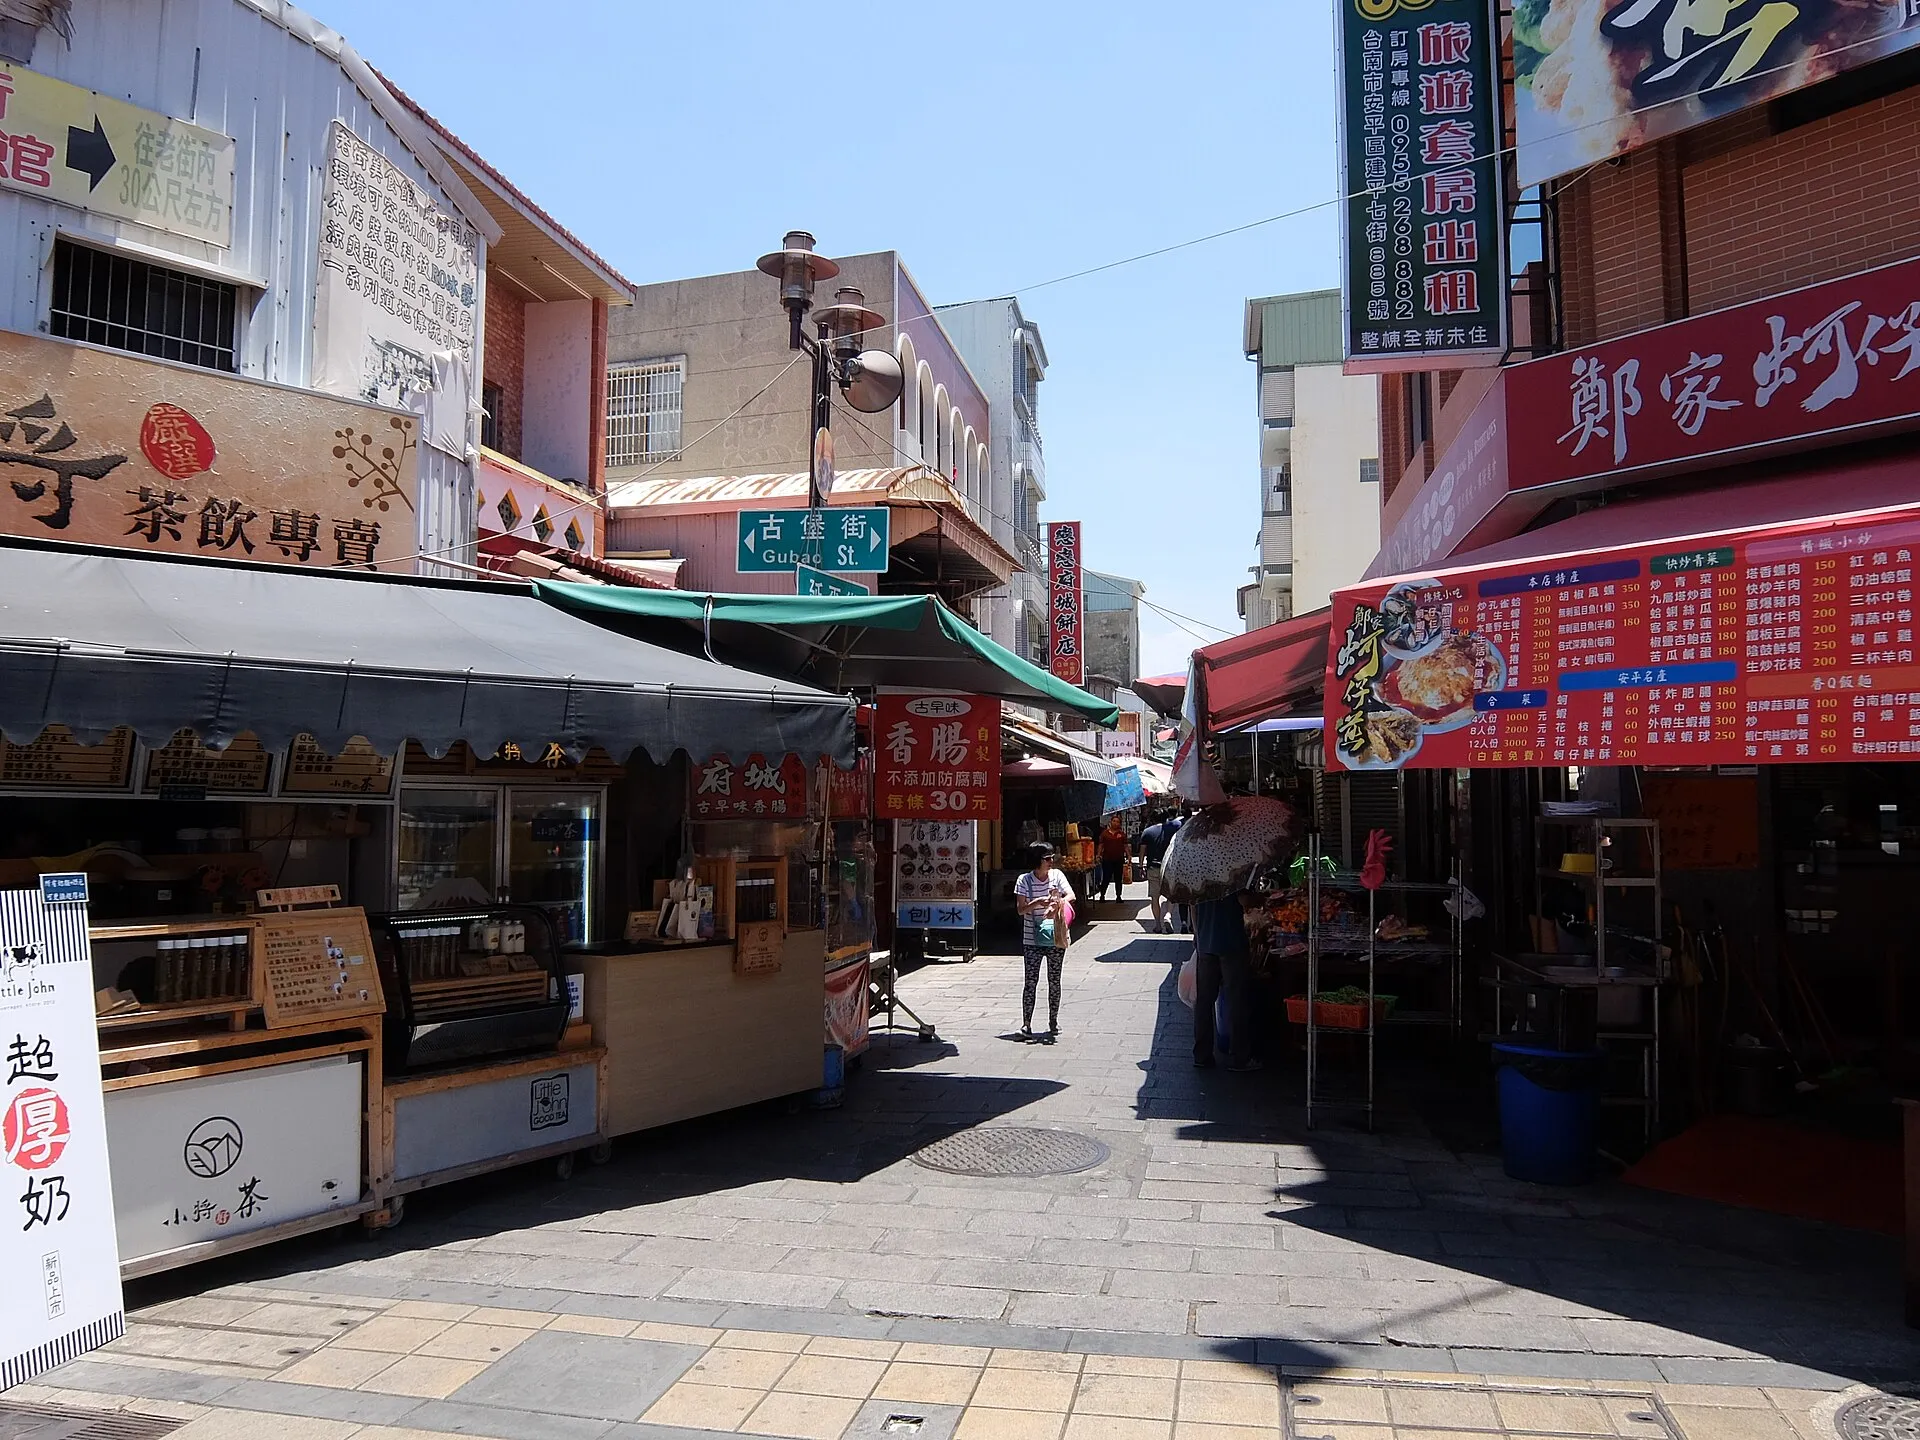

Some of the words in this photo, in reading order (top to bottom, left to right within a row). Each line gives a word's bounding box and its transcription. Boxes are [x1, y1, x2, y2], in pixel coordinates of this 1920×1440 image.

[1389, 30, 1411, 107] 訂房專線
[134, 120, 217, 185] 往老街內
[1361, 30, 1390, 320] 台南市安平區建平七街885號
[1417, 21, 1481, 316] 旅遊套房出租
[119, 164, 224, 234] 30公尺左方
[1361, 325, 1488, 350] 整棟全新未住
[123, 486, 382, 572] 茶飲專賣
[759, 513, 867, 541] 古堡街
[762, 549, 823, 564] Gubao
[837, 544, 859, 566] St.
[1665, 552, 1720, 570] 快炒青菜
[1850, 550, 1912, 567] 紅燒魚
[1815, 560, 1836, 570] 150
[1528, 570, 1580, 588] 本店特產
[1650, 573, 1713, 591] 炒青菜
[1717, 572, 1737, 582] 100
[1746, 579, 1800, 595] 快炒羊肉
[1812, 576, 1836, 586] 200
[809, 578, 858, 597] 延平
[1622, 584, 1640, 593] 350
[1423, 587, 1463, 603] 傳統小吃
[1650, 588, 1713, 604] 九層塔炒蛋
[1717, 587, 1737, 597] 100
[1812, 592, 1836, 602] 200
[1850, 589, 1912, 606] 三杯中卷
[1458, 605, 1470, 613] 60
[1476, 597, 1521, 612] 炒孔雀蛤
[1534, 594, 1551, 603] 300
[1622, 601, 1640, 610] 350
[1717, 602, 1737, 611] 180
[1533, 606, 1551, 615] 200
[1812, 608, 1836, 618] 200
[1851, 609, 1912, 626] 清蒸中卷
[1351, 606, 1384, 634] 鄭家
[1458, 616, 1469, 625] 60
[1533, 617, 1550, 627] 200
[1623, 617, 1640, 627] 180
[1717, 616, 1737, 626] 180
[1458, 628, 1469, 637] 60
[1533, 629, 1550, 638] 200
[1717, 631, 1737, 641] 180
[1746, 626, 1801, 641] 鐵板豆腐
[1812, 624, 1836, 634] 200
[1533, 641, 1550, 650] 200
[1717, 646, 1737, 656] 180
[1813, 640, 1837, 650] 250
[1532, 652, 1550, 661] 250
[1851, 649, 1912, 665] 三杯羊肉
[1532, 664, 1549, 673] 300
[1747, 658, 1802, 673] 生炒花枝
[1813, 657, 1837, 667] 200
[1532, 676, 1549, 685] 250
[1618, 670, 1668, 685] 安平名產
[1626, 692, 1639, 701] 60
[1649, 686, 1711, 701] 酥炸肥腸
[1717, 686, 1737, 695] 180
[915, 701, 961, 715] 古早味
[1625, 707, 1638, 716] 60
[1648, 701, 1711, 715] 炸中卷
[1715, 701, 1736, 710] 300
[1747, 699, 1809, 712] 招牌蒜頭飯
[1817, 699, 1837, 708] 100
[1505, 713, 1529, 721] 1000
[1537, 711, 1548, 722] 元
[1715, 716, 1736, 725] 300
[1821, 714, 1837, 723] 80
[1470, 725, 1496, 735] 8人份
[1504, 725, 1528, 734] 2000
[1537, 723, 1547, 734] 元
[1624, 721, 1638, 730] 60
[1714, 731, 1736, 740] 250
[1821, 729, 1837, 738] 80
[885, 721, 971, 766] 香腸
[975, 727, 991, 761] 自製
[1468, 738, 1498, 749] 12人份
[1503, 738, 1527, 747] 3000
[1536, 736, 1546, 748] 元
[1555, 735, 1612, 747] 花枝丸
[1624, 735, 1637, 744] 60
[1617, 750, 1637, 758] 200
[1820, 744, 1836, 754] 60
[697, 760, 786, 796] 府城
[886, 770, 988, 788] 不添加防腐劑
[696, 799, 788, 814] 古早味香腸
[886, 794, 925, 811] 每條
[930, 791, 967, 811] 30
[972, 795, 987, 811] 元
[908, 906, 963, 924] 刨冰
[28, 980, 55, 999] John
[535, 1082, 561, 1099] Little
[6, 1034, 71, 1231] 超厚奶
[46, 1256, 61, 1314] 新品上市
